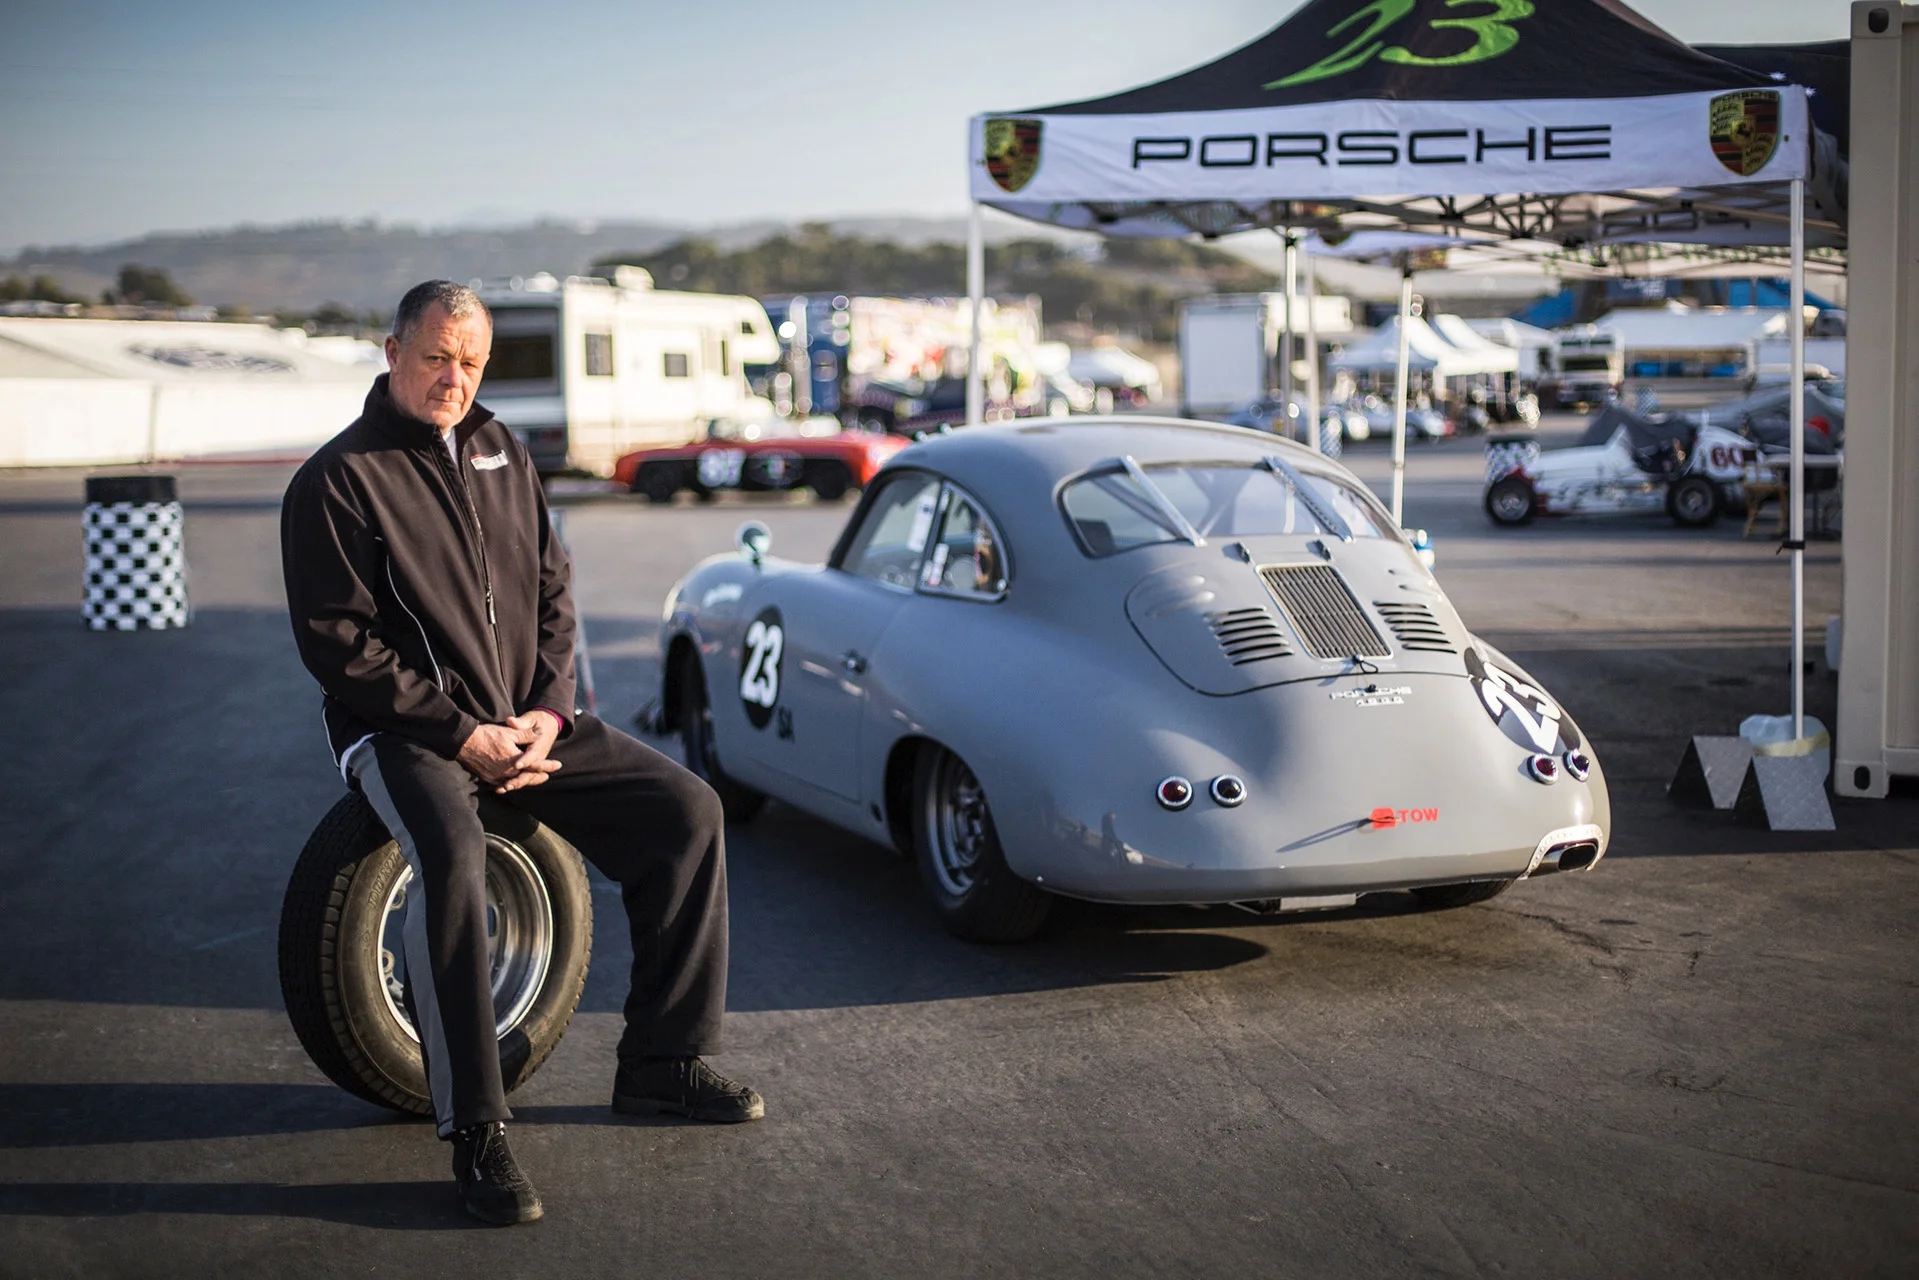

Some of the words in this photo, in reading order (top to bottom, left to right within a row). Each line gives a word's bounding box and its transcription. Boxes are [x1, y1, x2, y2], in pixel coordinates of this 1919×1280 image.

[1260, 0, 1536, 90] 23
[1132, 125, 1612, 169] PORSCHE
[741, 620, 784, 708] 23
[1482, 661, 1561, 754] 23
[1397, 807, 1439, 824] TOW
[368, 851, 400, 909] DUNL
